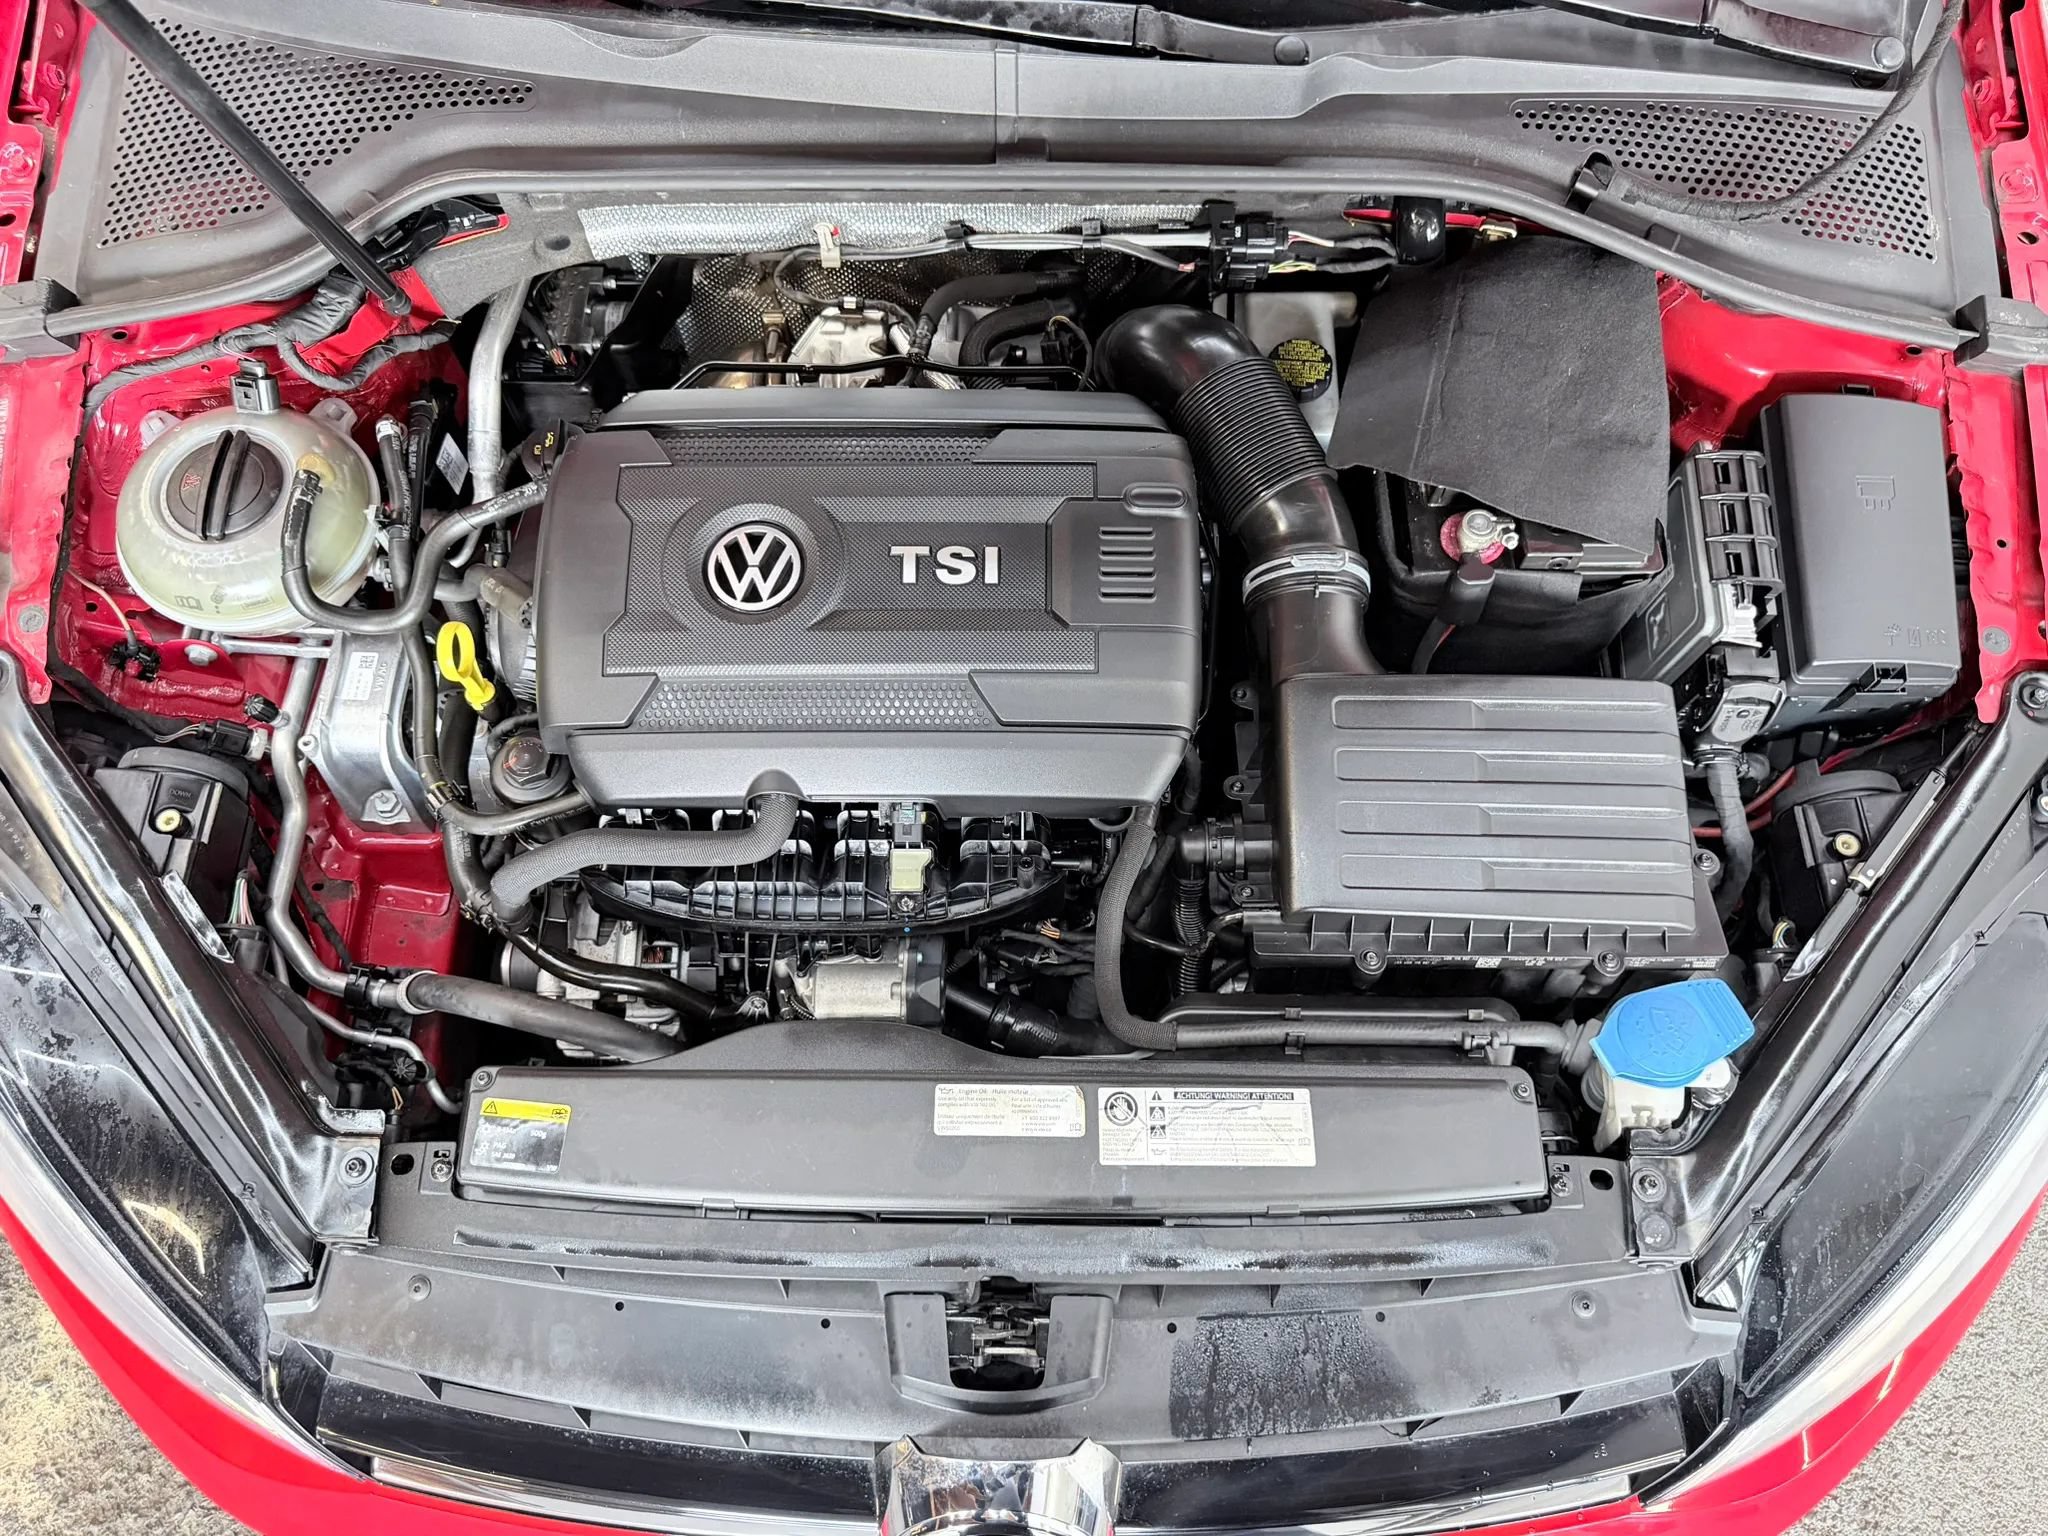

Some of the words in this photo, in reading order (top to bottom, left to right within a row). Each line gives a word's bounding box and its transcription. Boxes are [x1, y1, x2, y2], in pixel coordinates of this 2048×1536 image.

[890, 545, 1000, 585] TSI
[958, 1088, 978, 1096] Engine
[1176, 1092, 1214, 1100] ACHTUNG!
[1215, 1092, 1251, 1100] WARNING!
[1252, 1092, 1294, 1101] ATTENTION!
[530, 1130, 548, 1140] 500g
[493, 1142, 507, 1150] PAG
